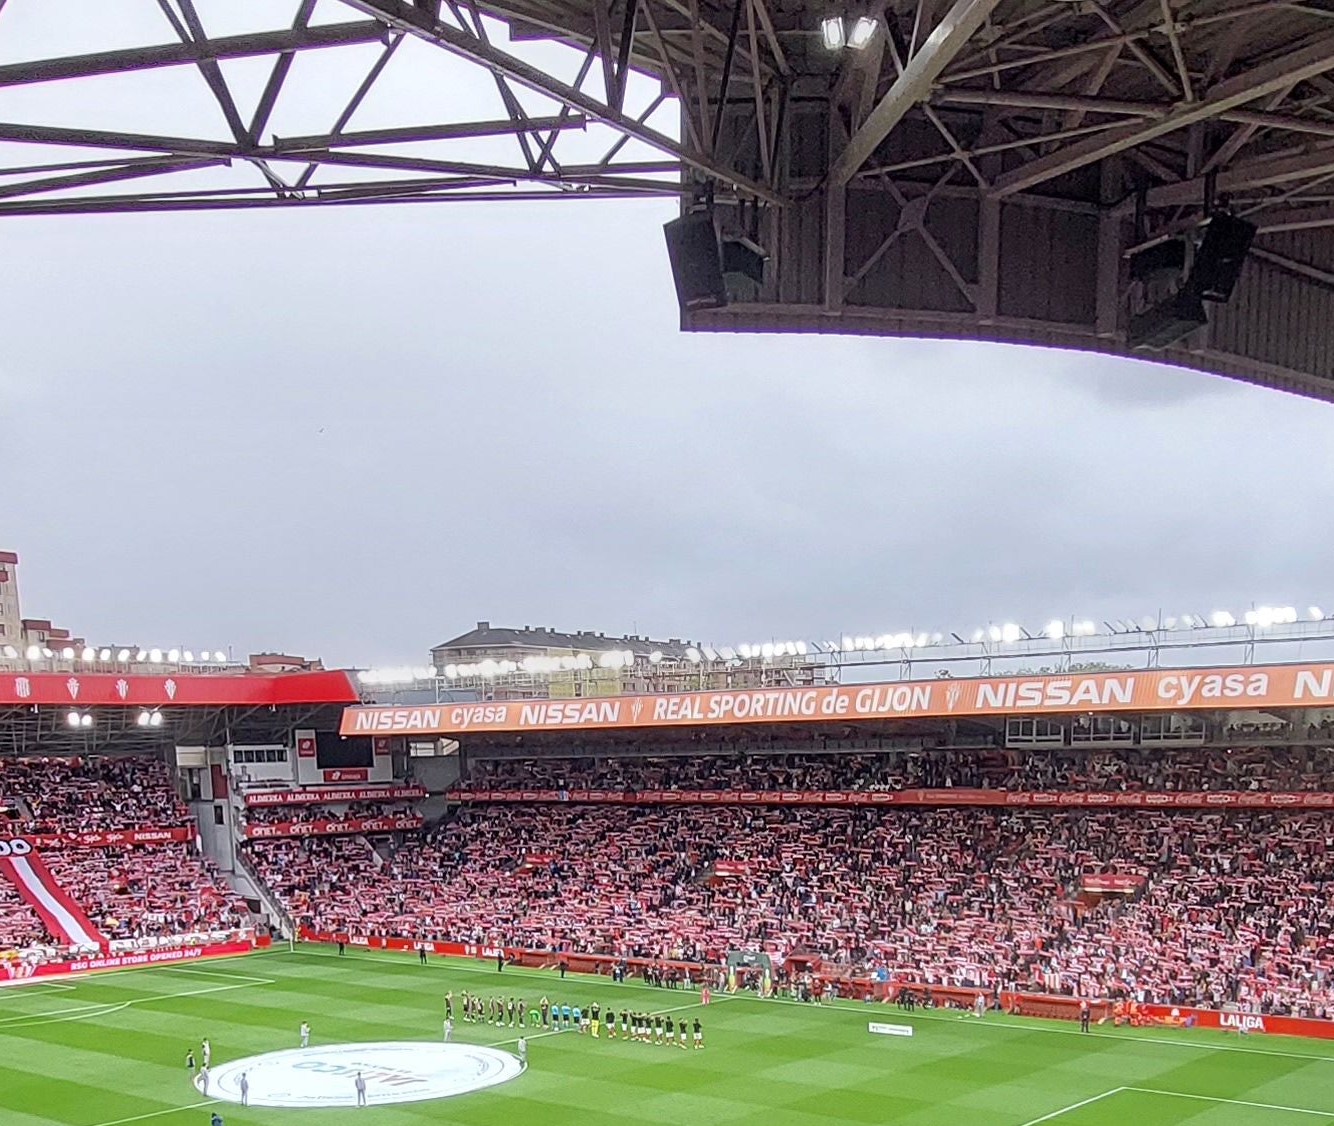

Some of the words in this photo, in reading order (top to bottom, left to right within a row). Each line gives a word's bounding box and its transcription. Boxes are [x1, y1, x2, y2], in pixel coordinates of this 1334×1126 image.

[653, 696, 704, 720] REAL
[706, 690, 817, 719] SPORTING
[821, 690, 848, 715] de
[855, 685, 932, 713] GIJON
[975, 677, 1135, 709] NISSAN
[1157, 672, 1269, 705] cyasa
[355, 707, 441, 731] NISSAN
[450, 705, 507, 729] cyasa
[519, 701, 621, 725] NISSAN
[134, 831, 172, 841] NISSAN
[1219, 1012, 1265, 1030] LALIGA
